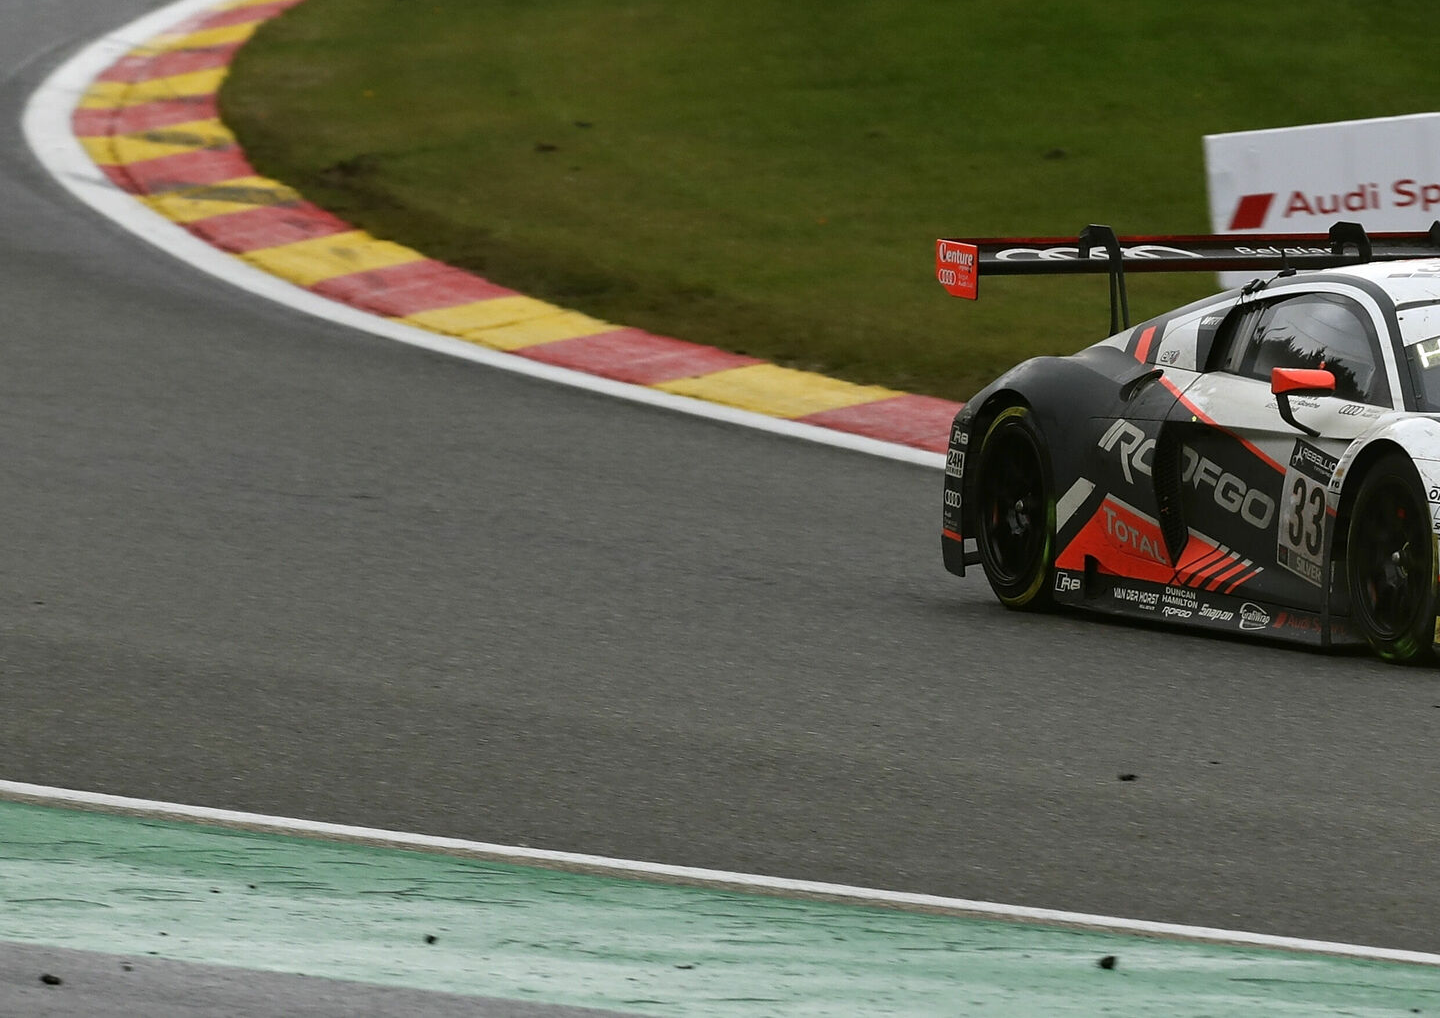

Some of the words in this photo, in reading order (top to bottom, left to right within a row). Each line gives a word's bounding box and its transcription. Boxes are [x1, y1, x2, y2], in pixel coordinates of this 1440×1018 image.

[1283, 183, 1381, 219] Audi
[1300, 446, 1338, 473] REBELLIO
[1288, 477, 1326, 556] 33
[1103, 506, 1167, 564] TOTAL
[1296, 556, 1322, 582] SILVER
[1114, 587, 1127, 600] VAN
[1126, 589, 1139, 602] DER
[1138, 591, 1160, 605] HORST
[1161, 594, 1199, 609] HAMILTON
[1165, 586, 1196, 600] DUNCAN
